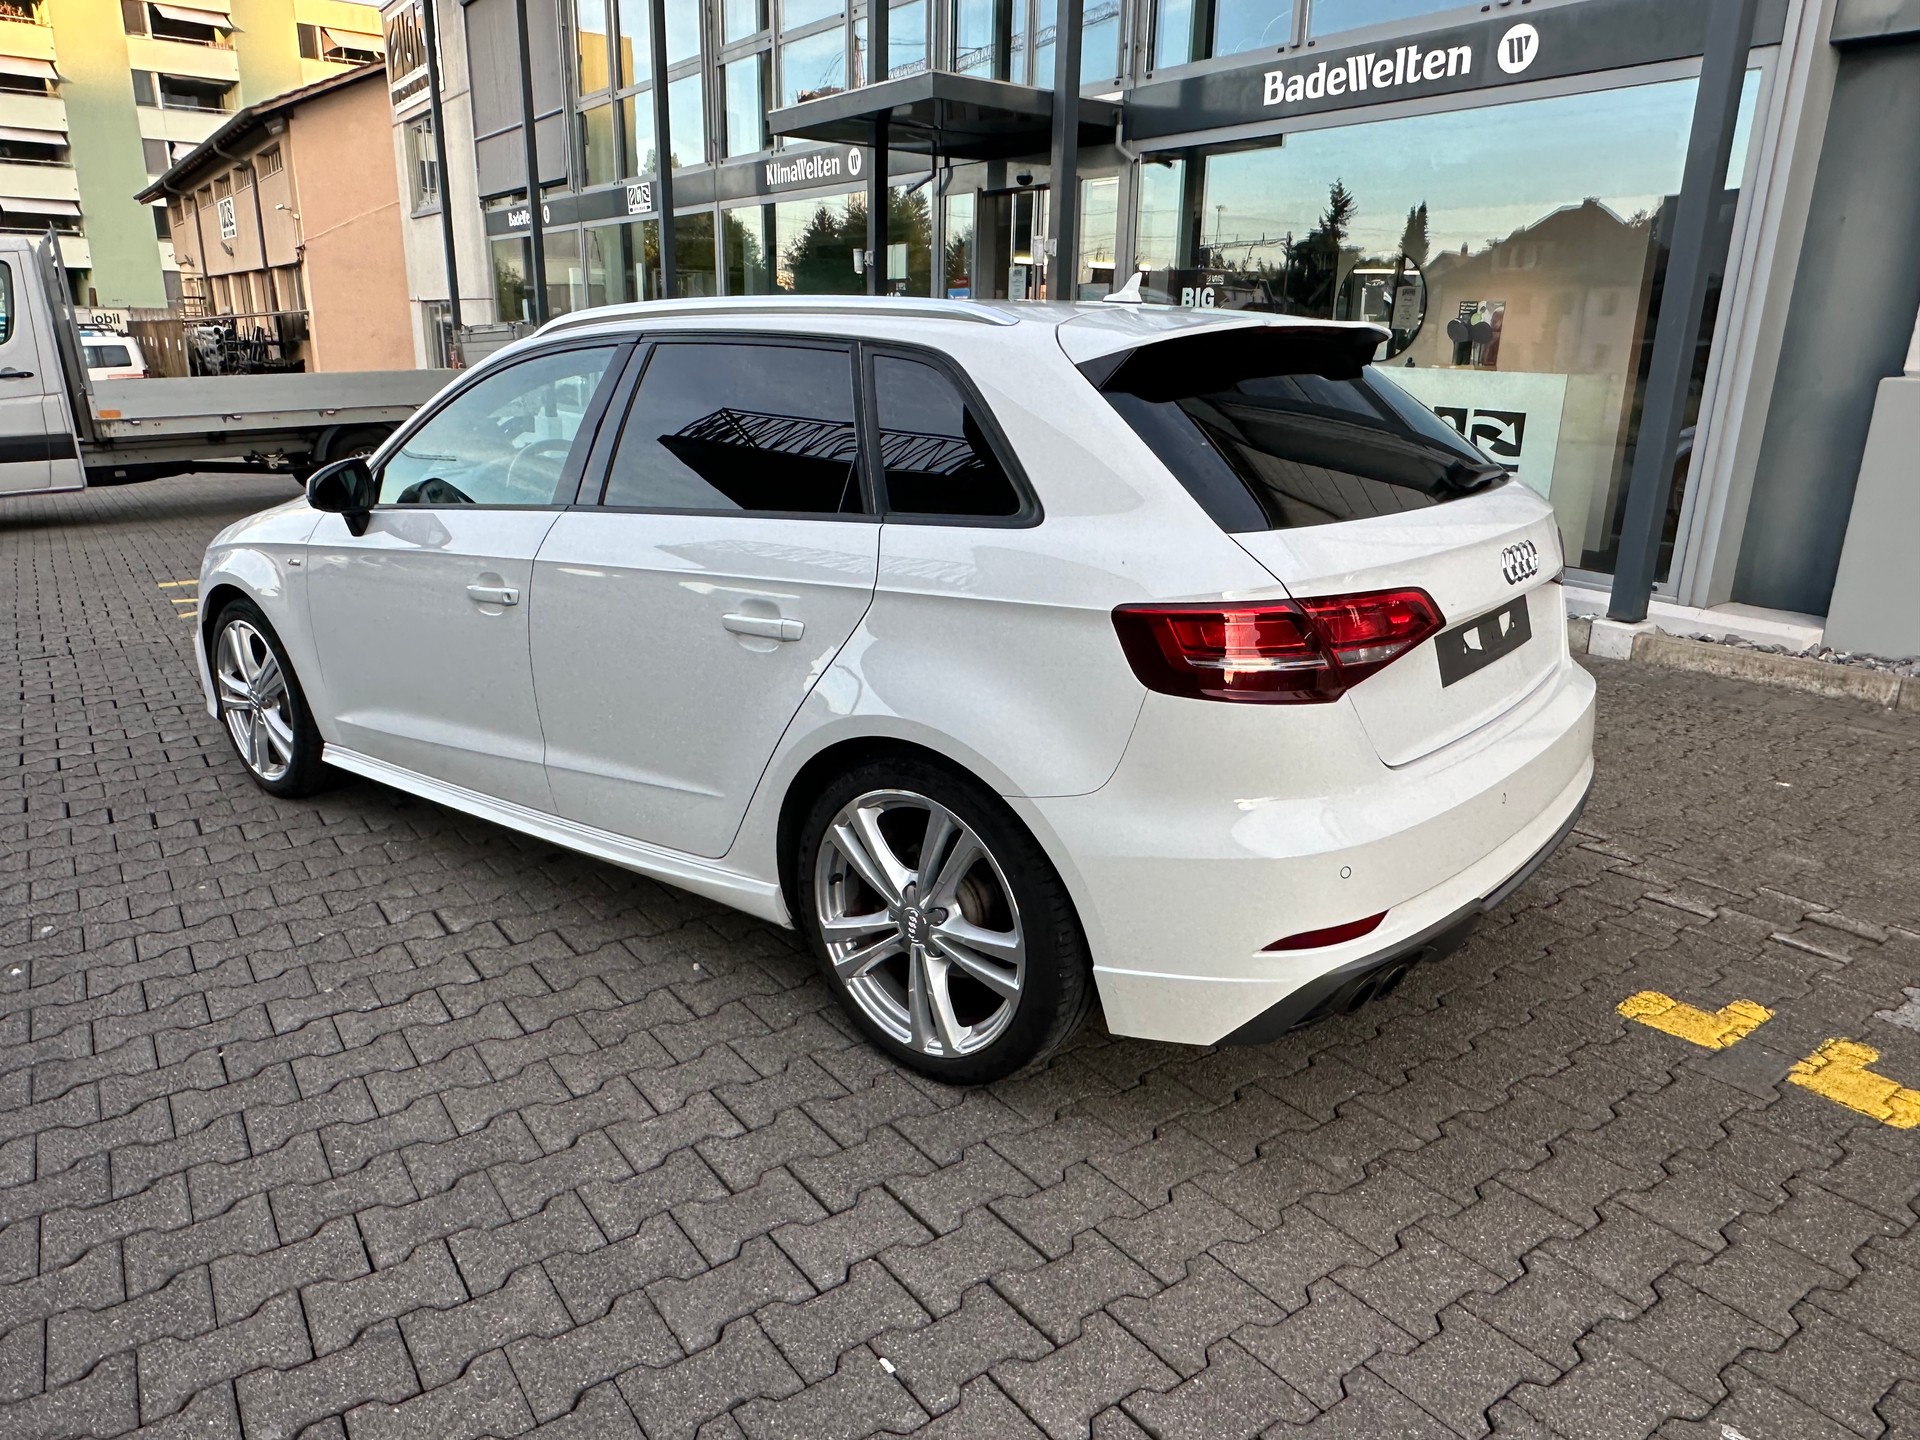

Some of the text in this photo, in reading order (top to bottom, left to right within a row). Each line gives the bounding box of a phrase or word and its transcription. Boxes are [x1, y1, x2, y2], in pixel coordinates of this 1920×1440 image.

[1263, 45, 1472, 106] BadeWelten
[765, 155, 840, 186] KlimaWelten
[1181, 287, 1215, 308] BIG
